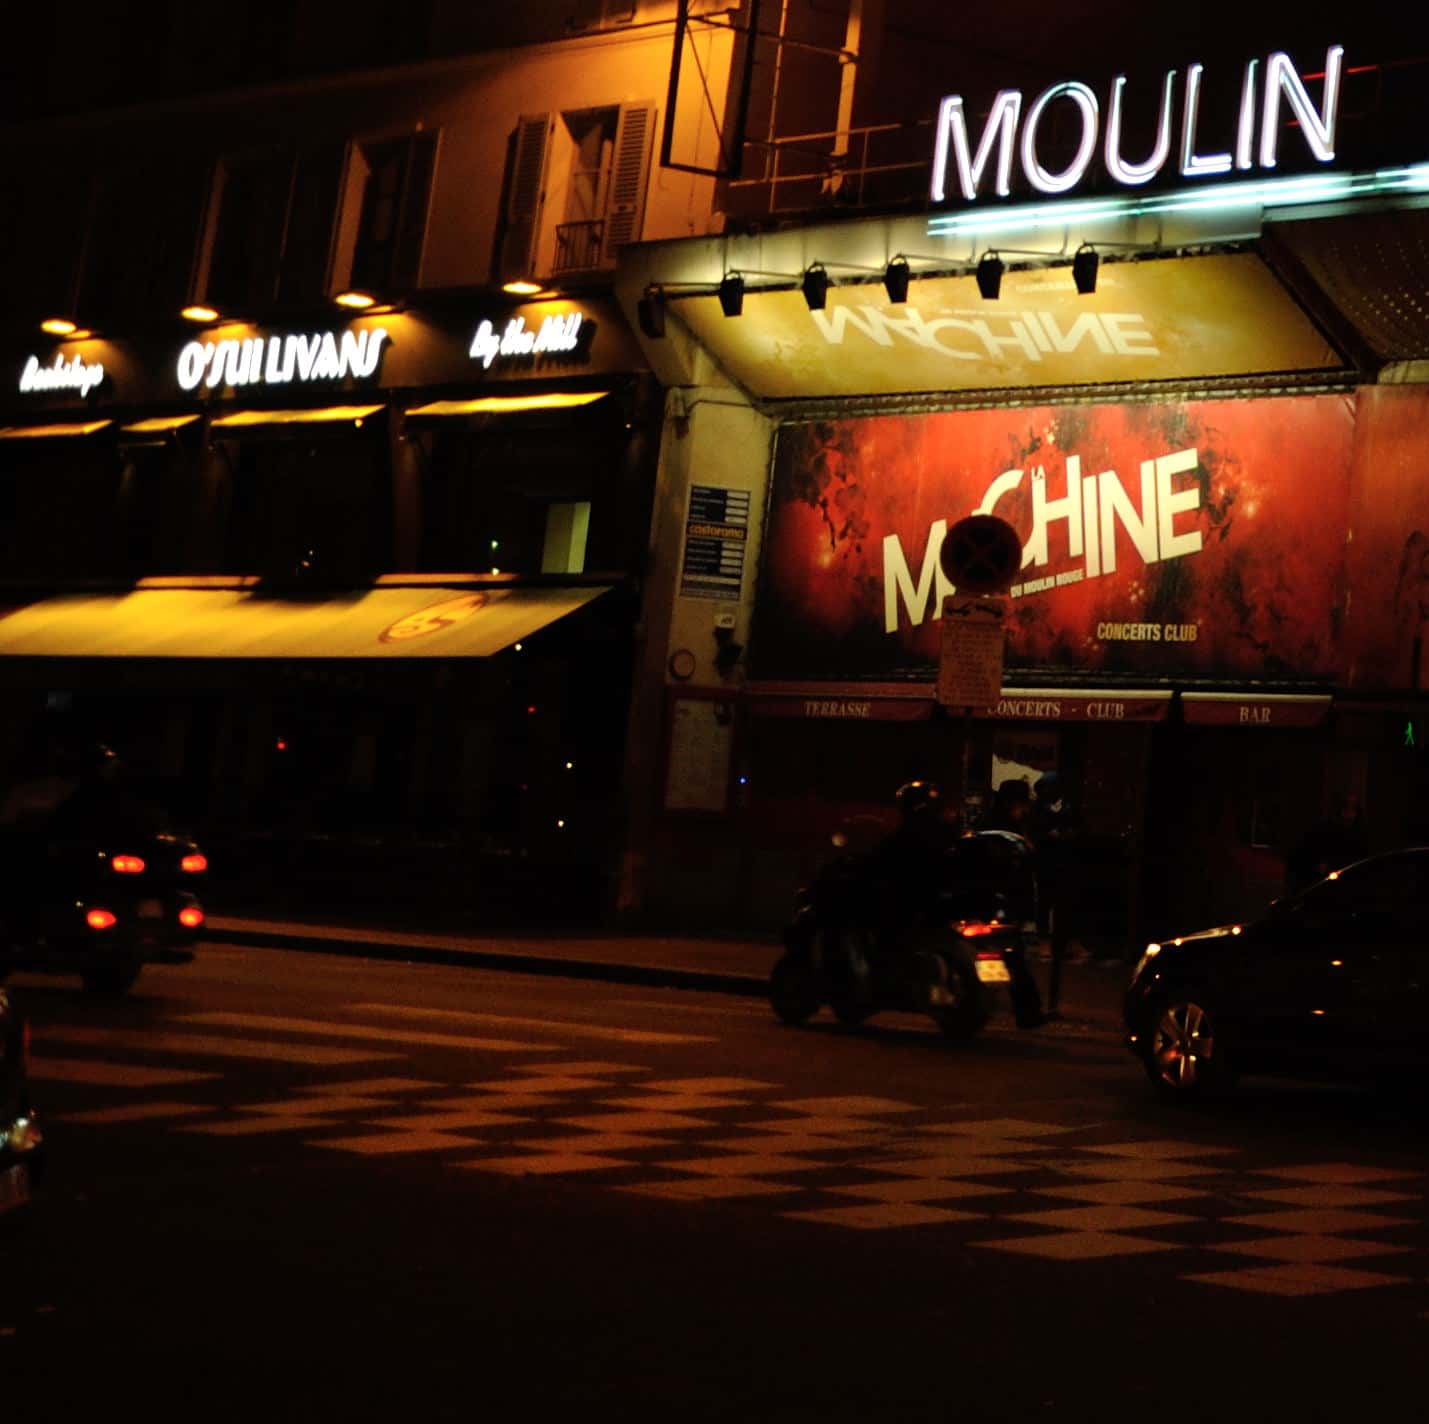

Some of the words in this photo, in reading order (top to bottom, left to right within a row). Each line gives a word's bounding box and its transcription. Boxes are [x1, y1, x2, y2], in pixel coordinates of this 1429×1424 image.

[930, 44, 1344, 202] MOULIN
[883, 447, 1203, 634] MCHINE
[1097, 622, 1161, 641] CONCERTS
[1164, 623, 1198, 642] CLUB
[804, 701, 871, 718] TERRASSE
[1086, 702, 1125, 719] CLUB
[1239, 706, 1271, 723] BAR
